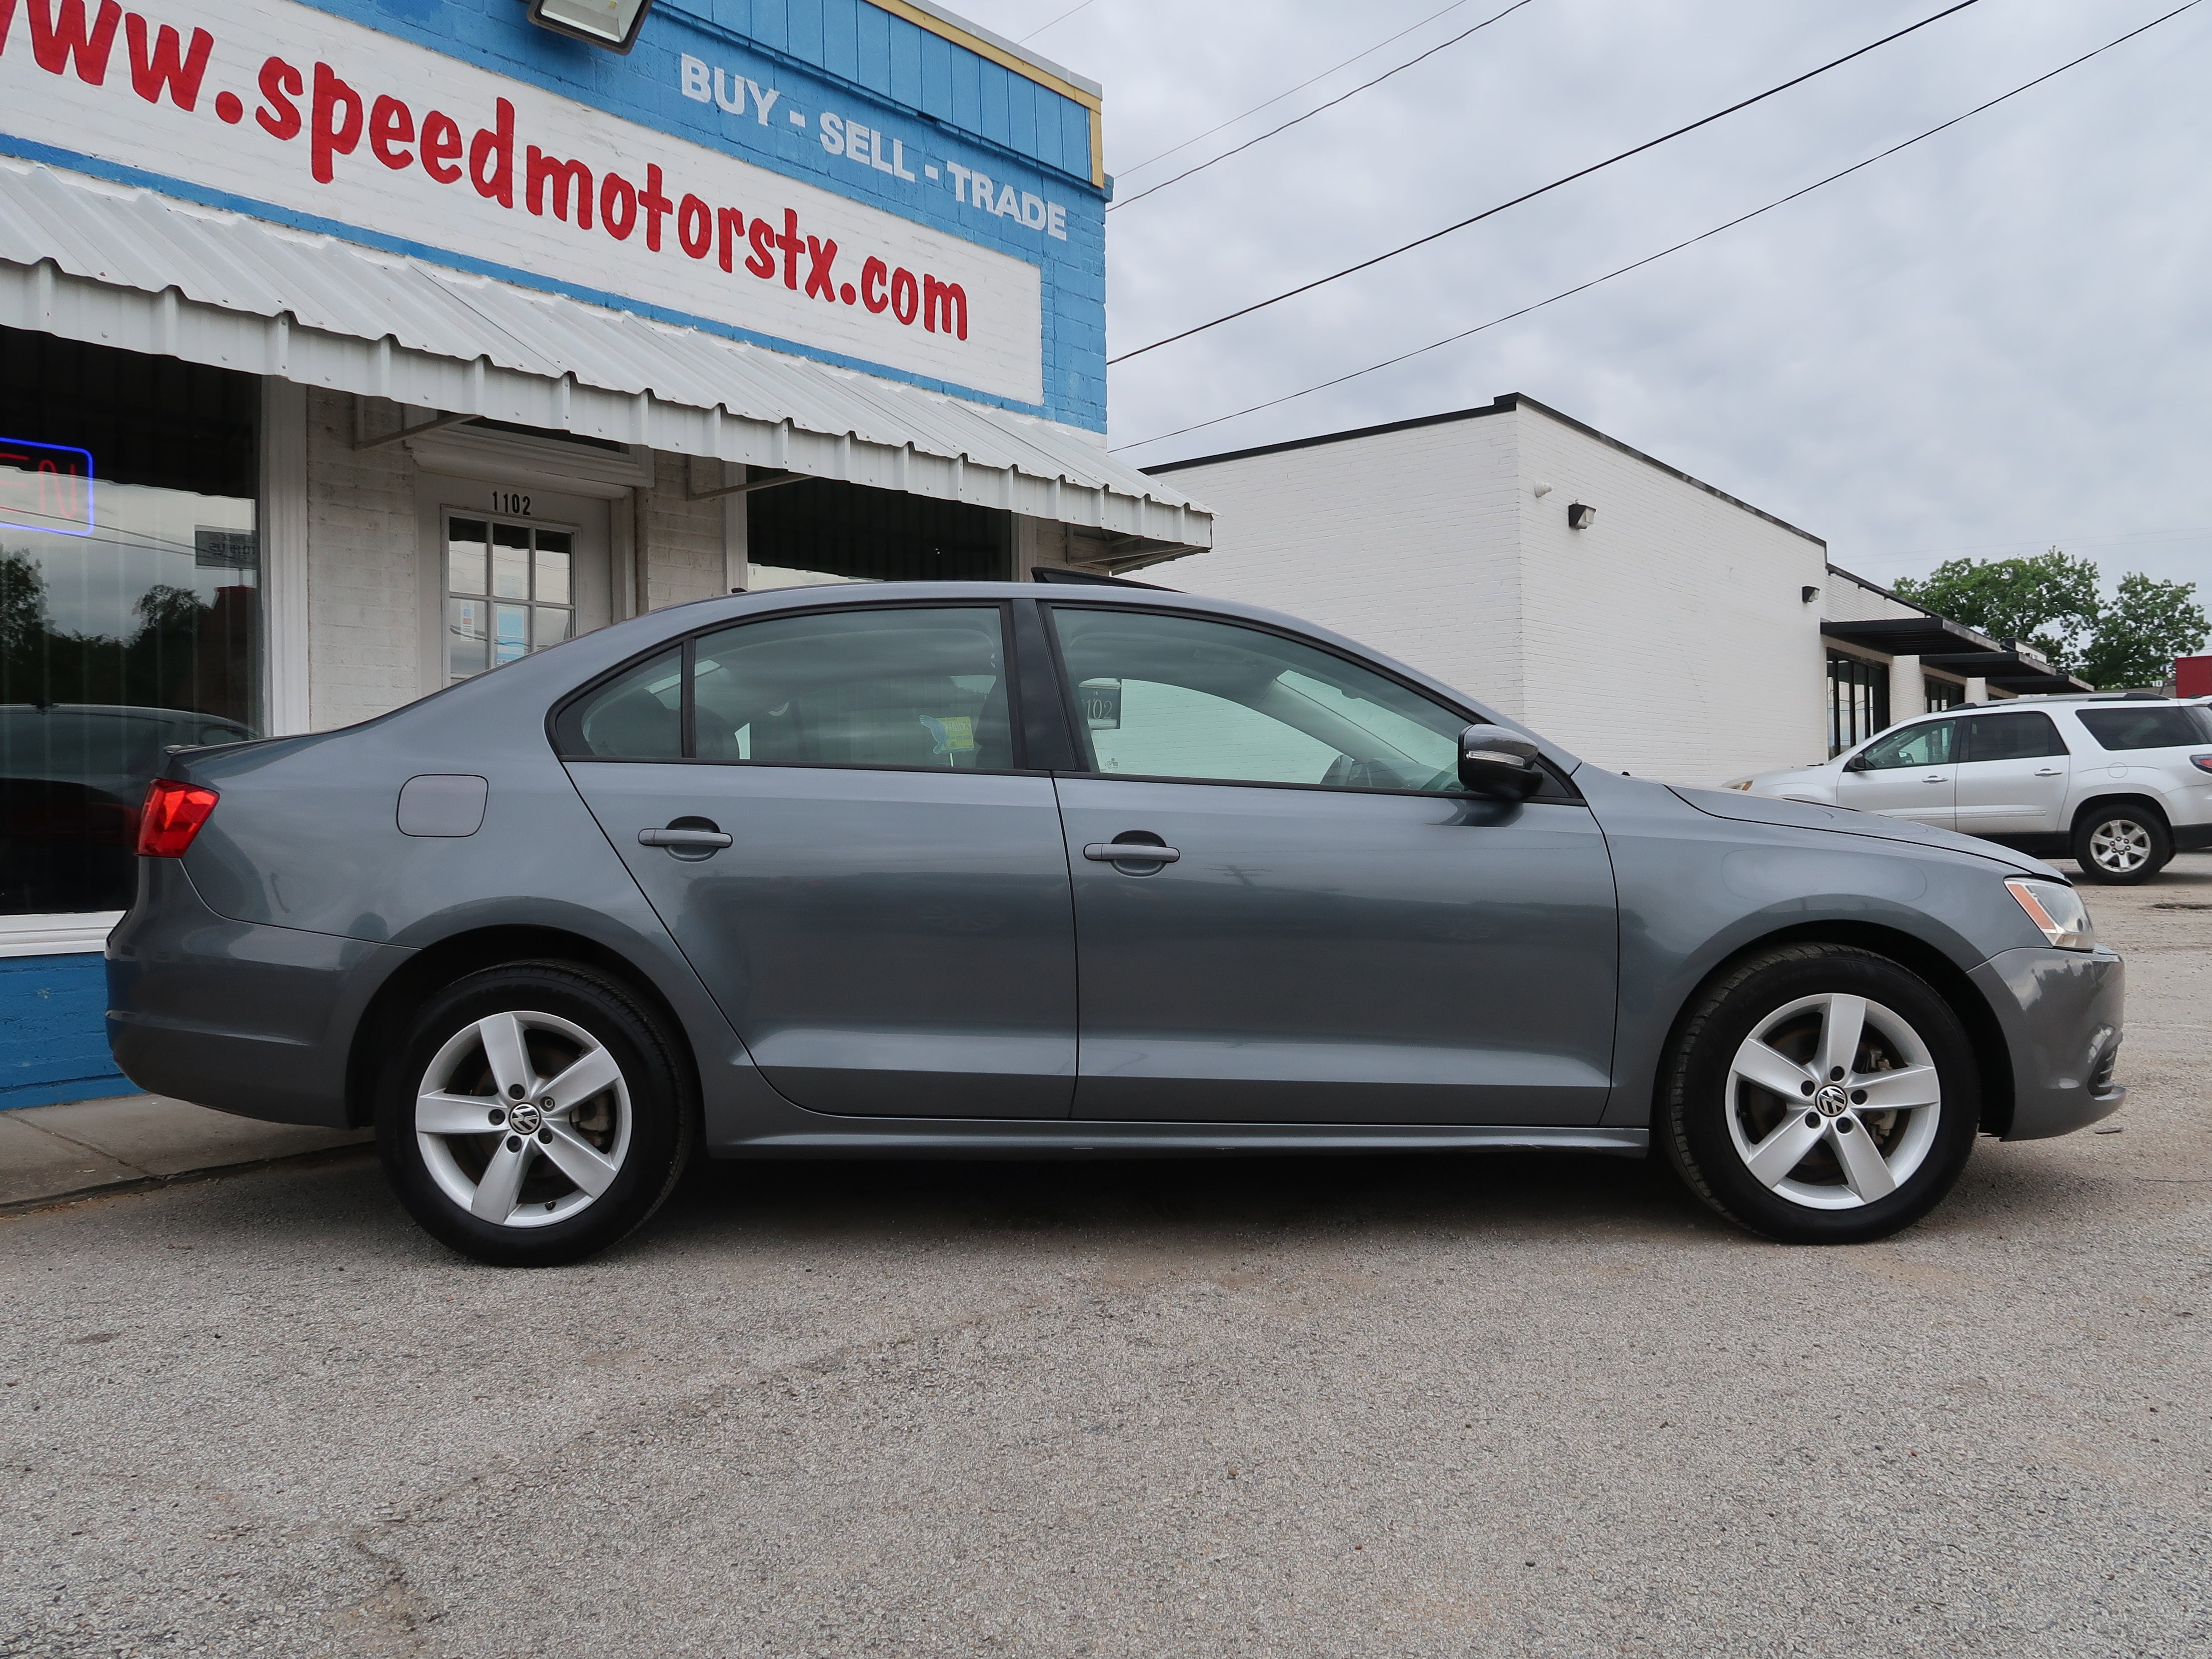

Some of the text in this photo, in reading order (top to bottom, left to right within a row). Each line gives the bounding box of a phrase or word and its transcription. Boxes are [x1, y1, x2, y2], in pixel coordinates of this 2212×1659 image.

[0, 0, 967, 341] ww.speedmotorstx.com
[681, 52, 780, 126] BUY
[819, 111, 915, 182] SELL
[947, 160, 1067, 241] TRADE
[493, 491, 531, 515] 1102
